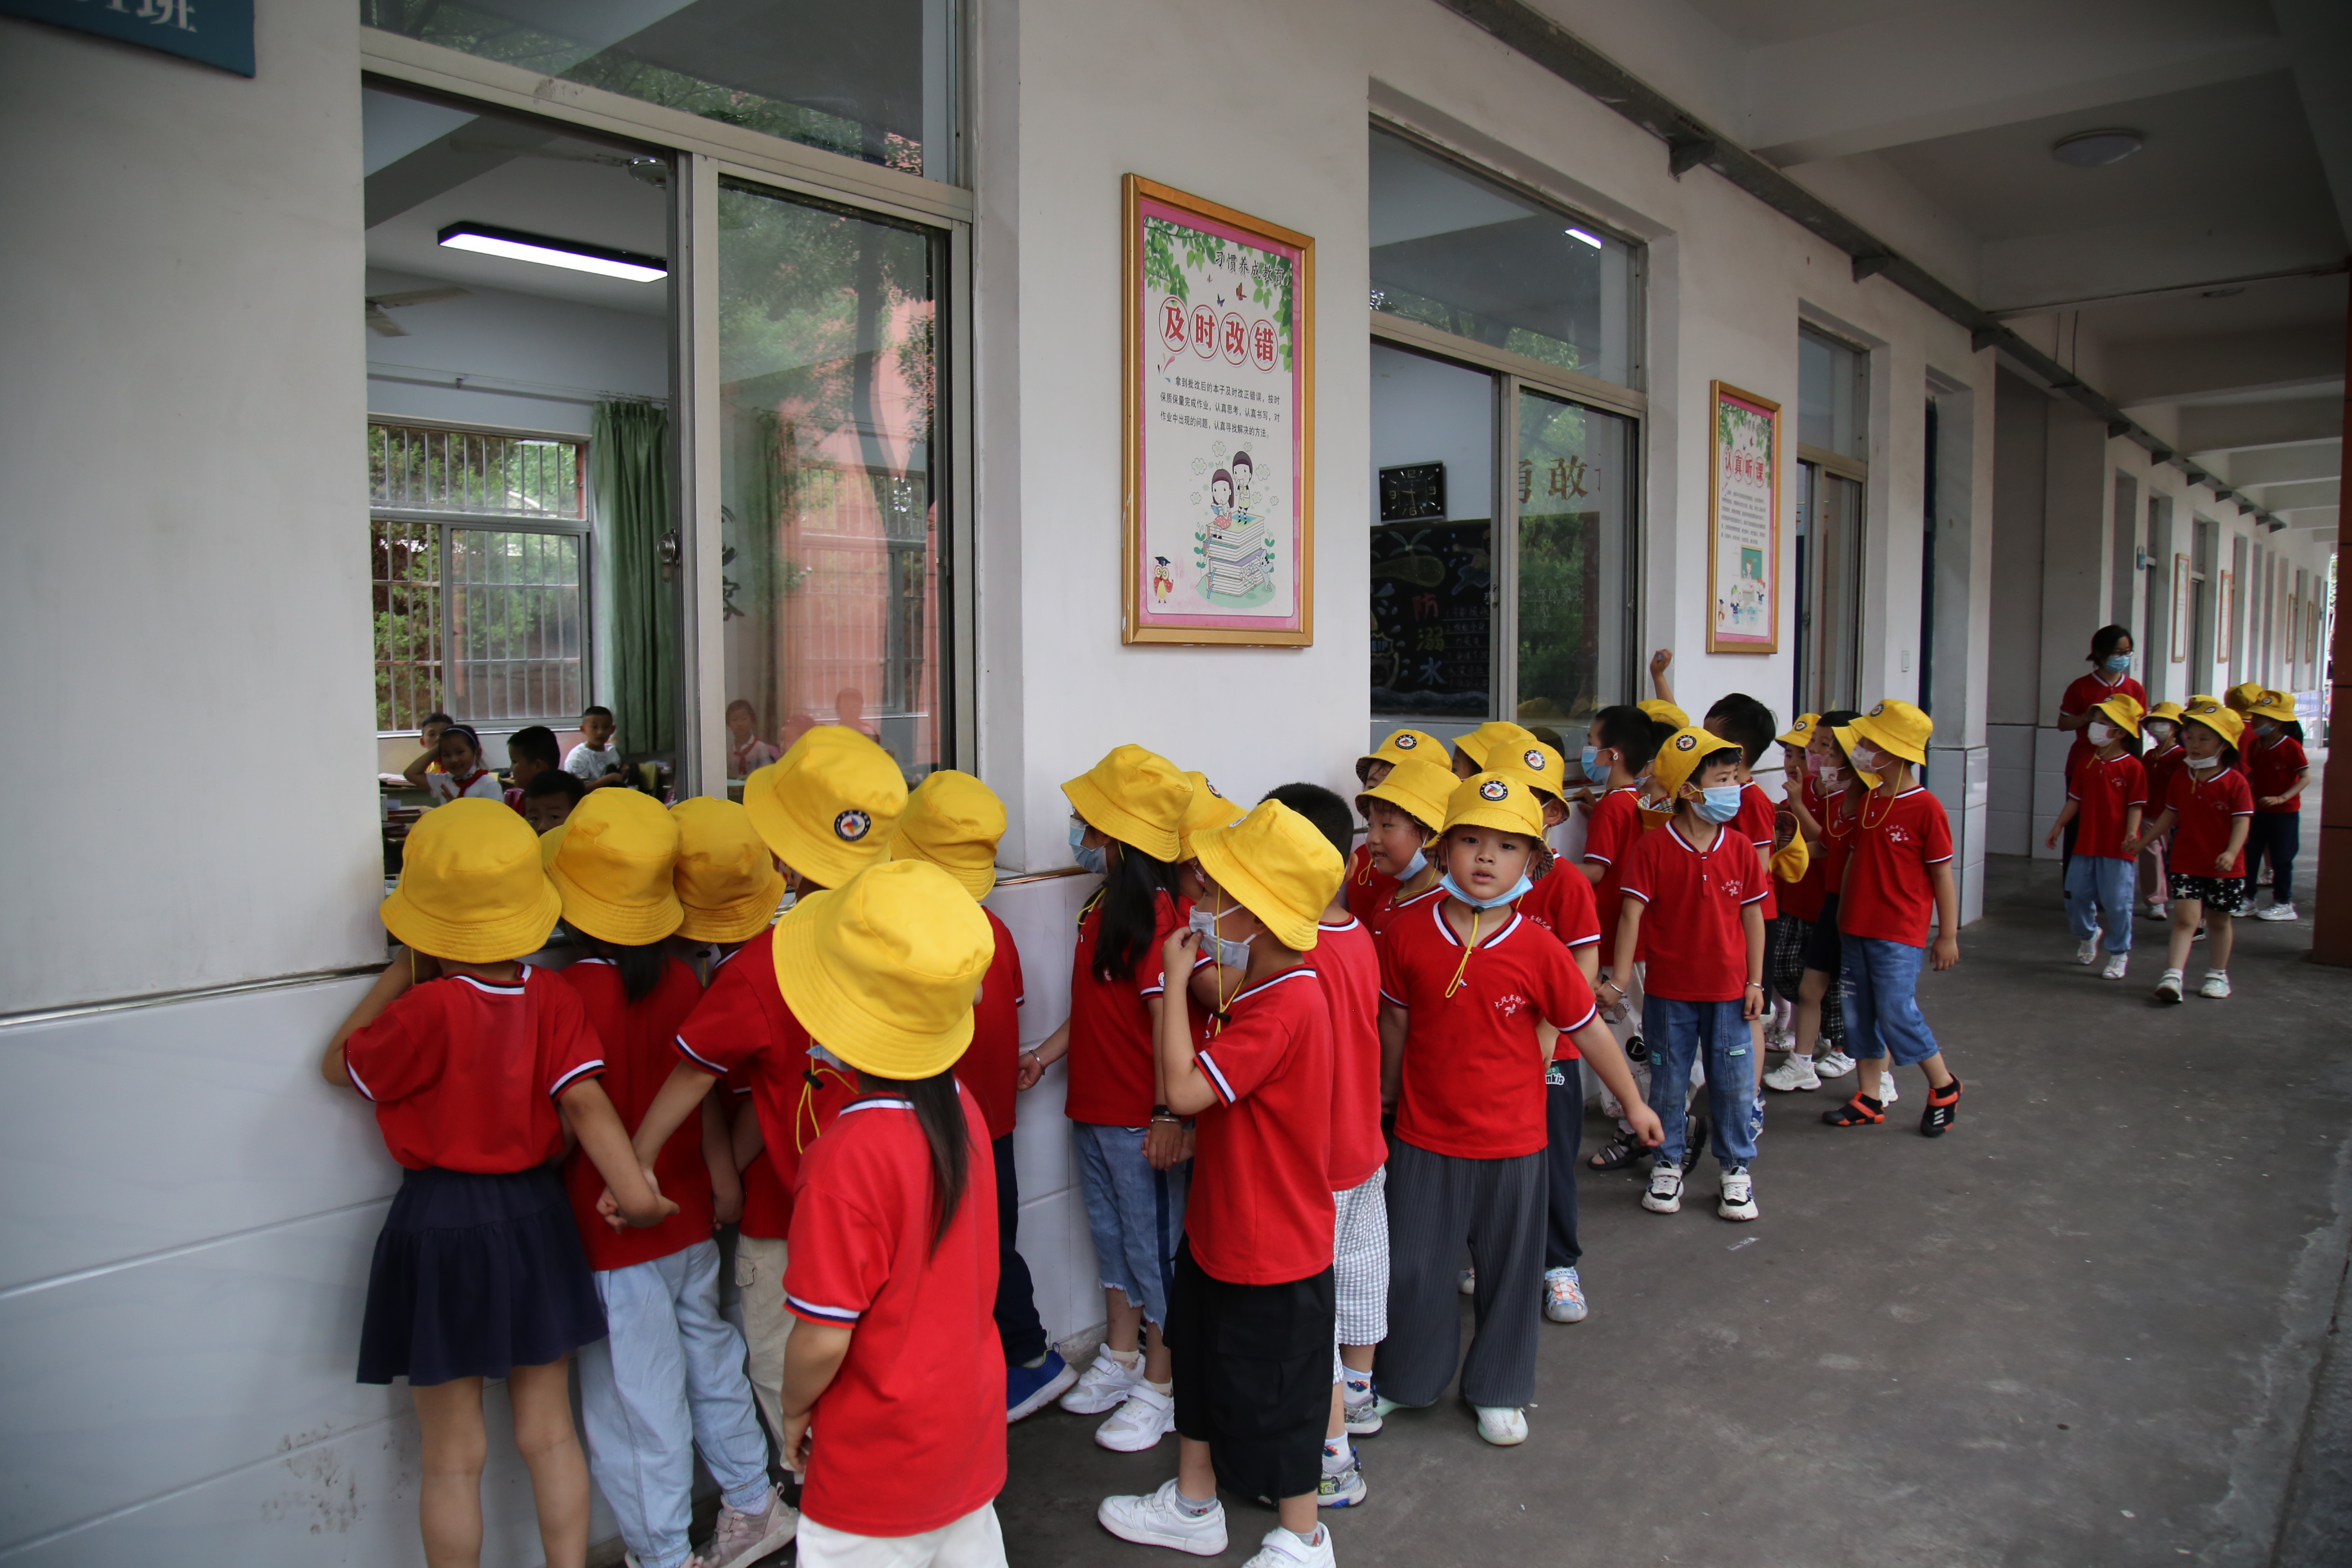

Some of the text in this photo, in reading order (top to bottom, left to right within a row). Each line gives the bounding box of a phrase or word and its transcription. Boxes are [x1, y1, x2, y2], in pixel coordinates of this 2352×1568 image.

[1215, 251, 1284, 286] 习惯养成教育
[1164, 306, 1274, 362] 及时改错
[1725, 452, 1763, 482] 认真听课
[1412, 592, 1448, 686] 防溺水
[1546, 1073, 1565, 1085] nkis
